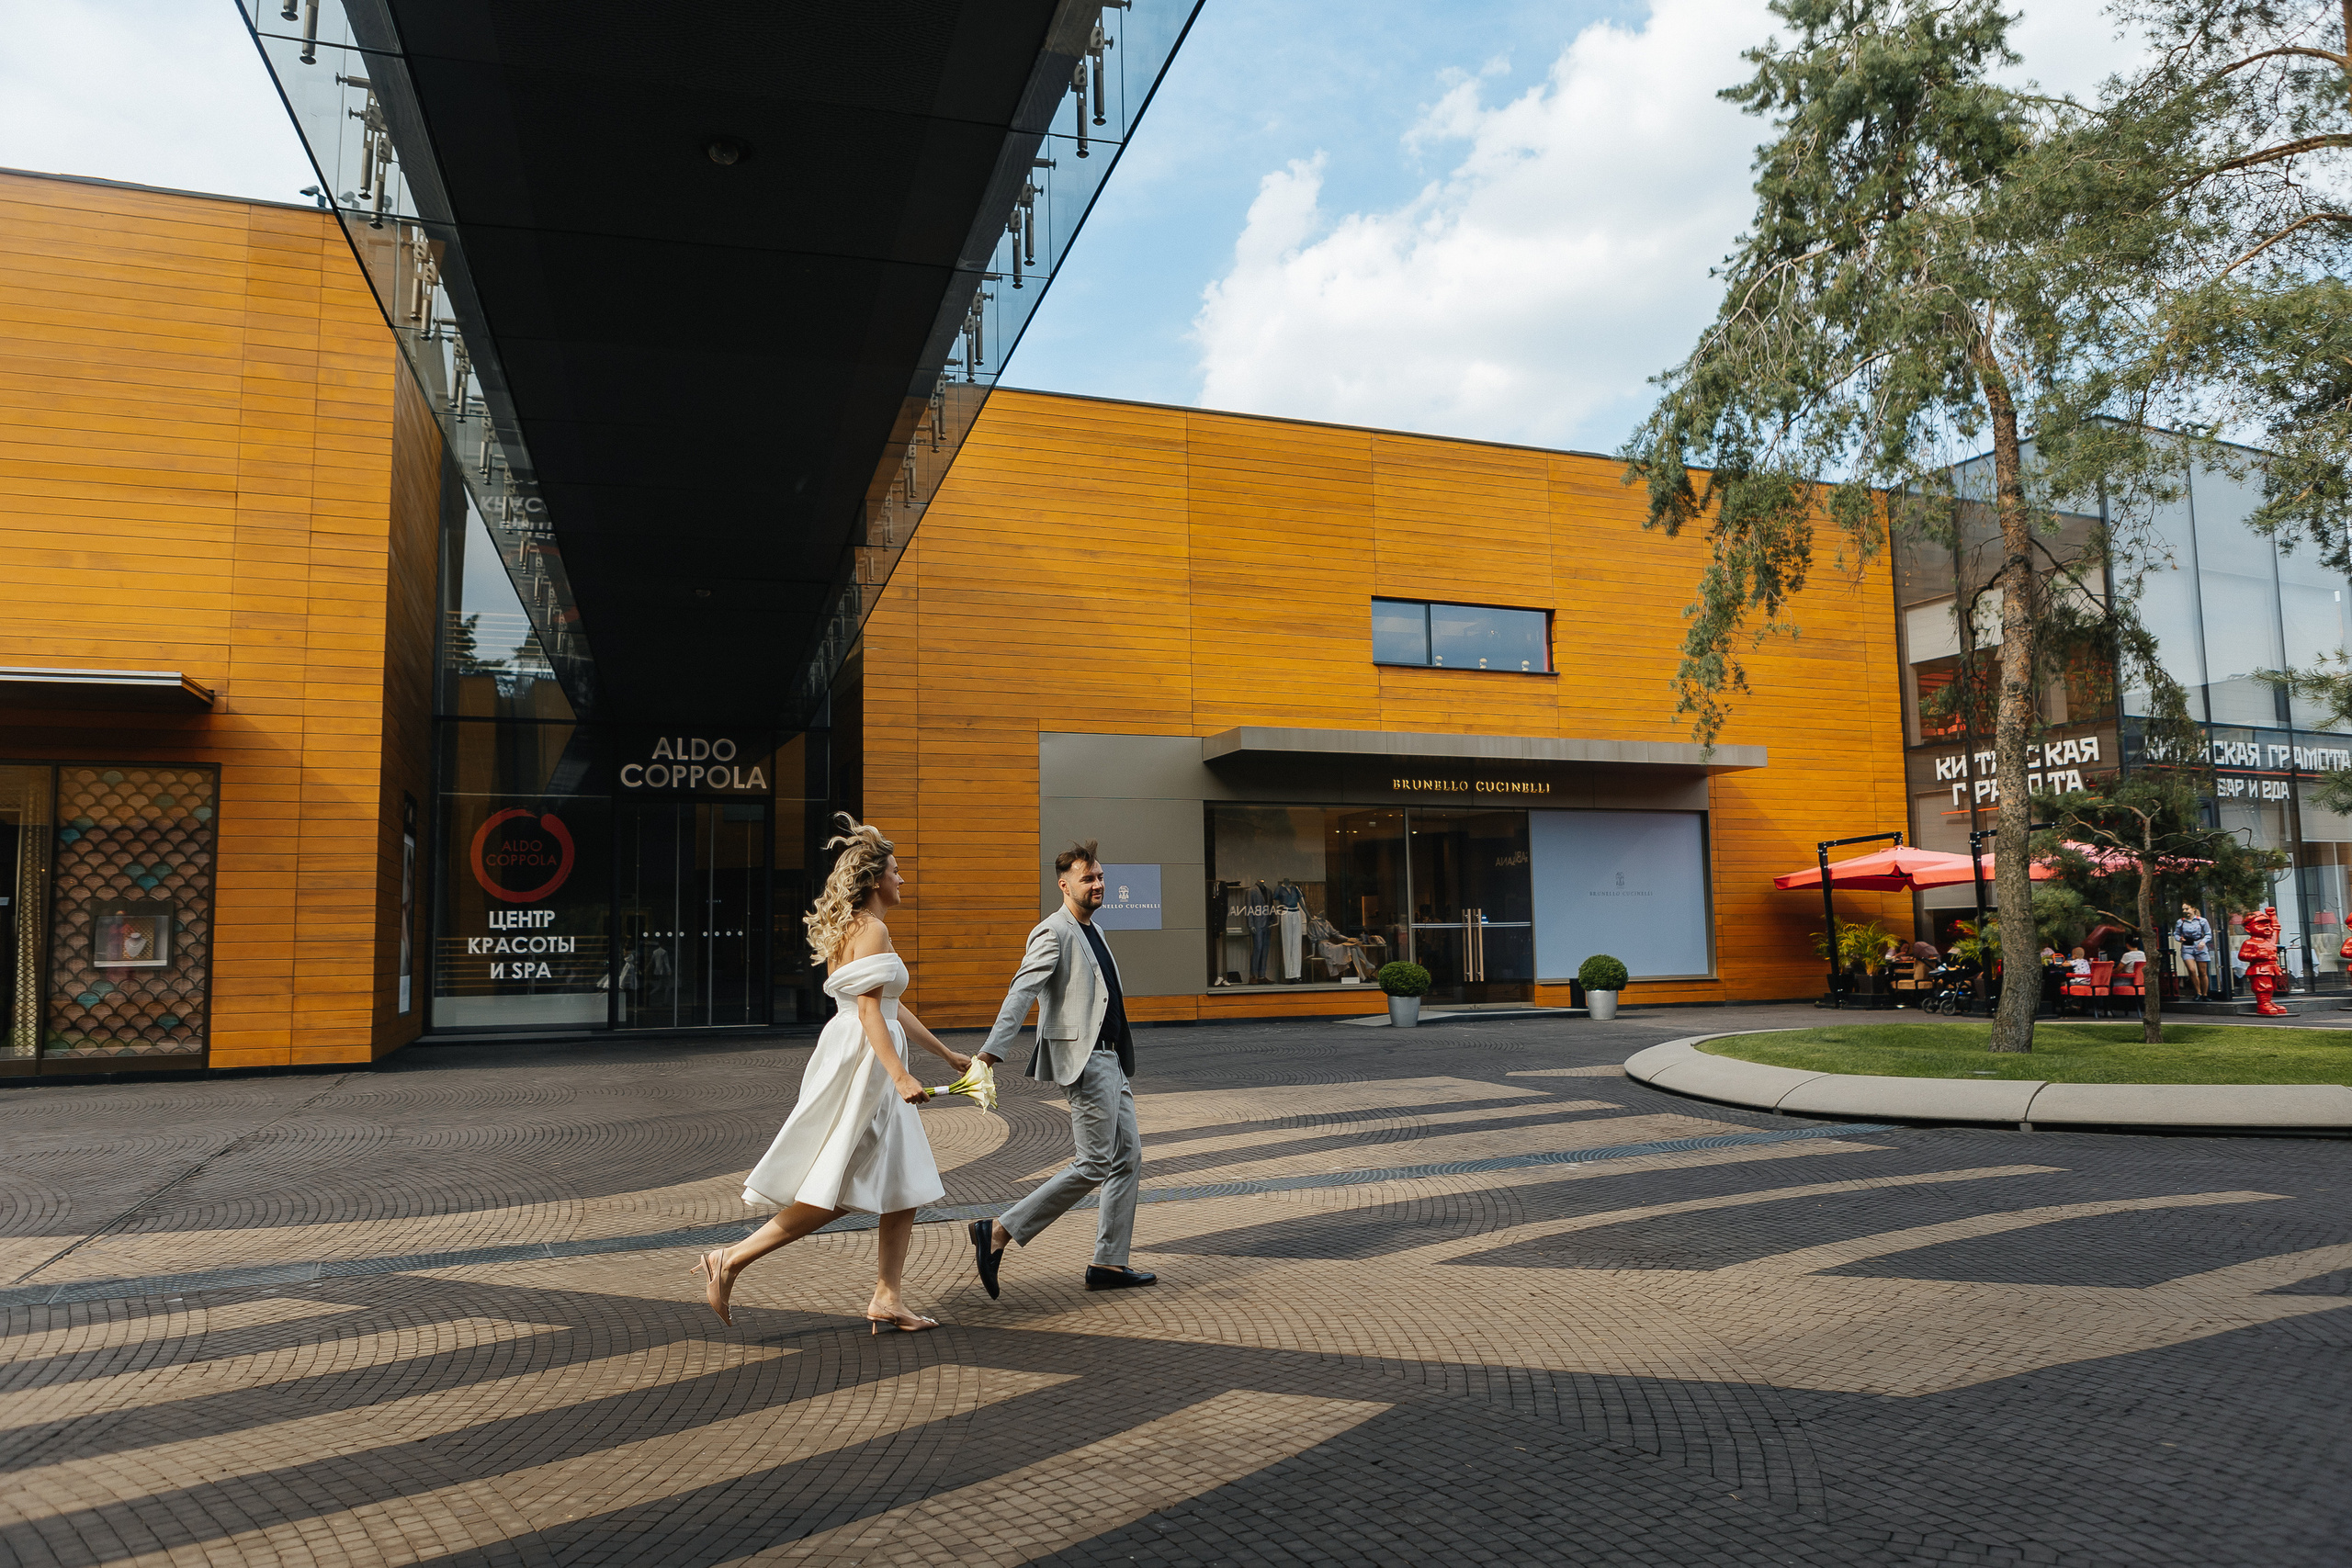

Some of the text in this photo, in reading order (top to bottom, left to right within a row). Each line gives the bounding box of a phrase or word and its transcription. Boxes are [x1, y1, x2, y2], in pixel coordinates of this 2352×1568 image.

[651, 737, 737, 761] ALDO
[1935, 736, 2100, 781] КИТСКАЯ
[2267, 743, 2352, 772] ГРАМОТА
[620, 763, 768, 789] COPPOLA
[1392, 778, 1551, 794] BRUNELLO CUCINELLI
[1951, 768, 2085, 807] ГРАОТА
[2248, 779, 2258, 798] И
[501, 840, 543, 852] ALDO
[486, 853, 558, 866] COPPOLA
[489, 909, 556, 931] ЦЕНТР
[468, 936, 575, 954] КРАСОТЫ
[490, 961, 552, 979] И SPA
